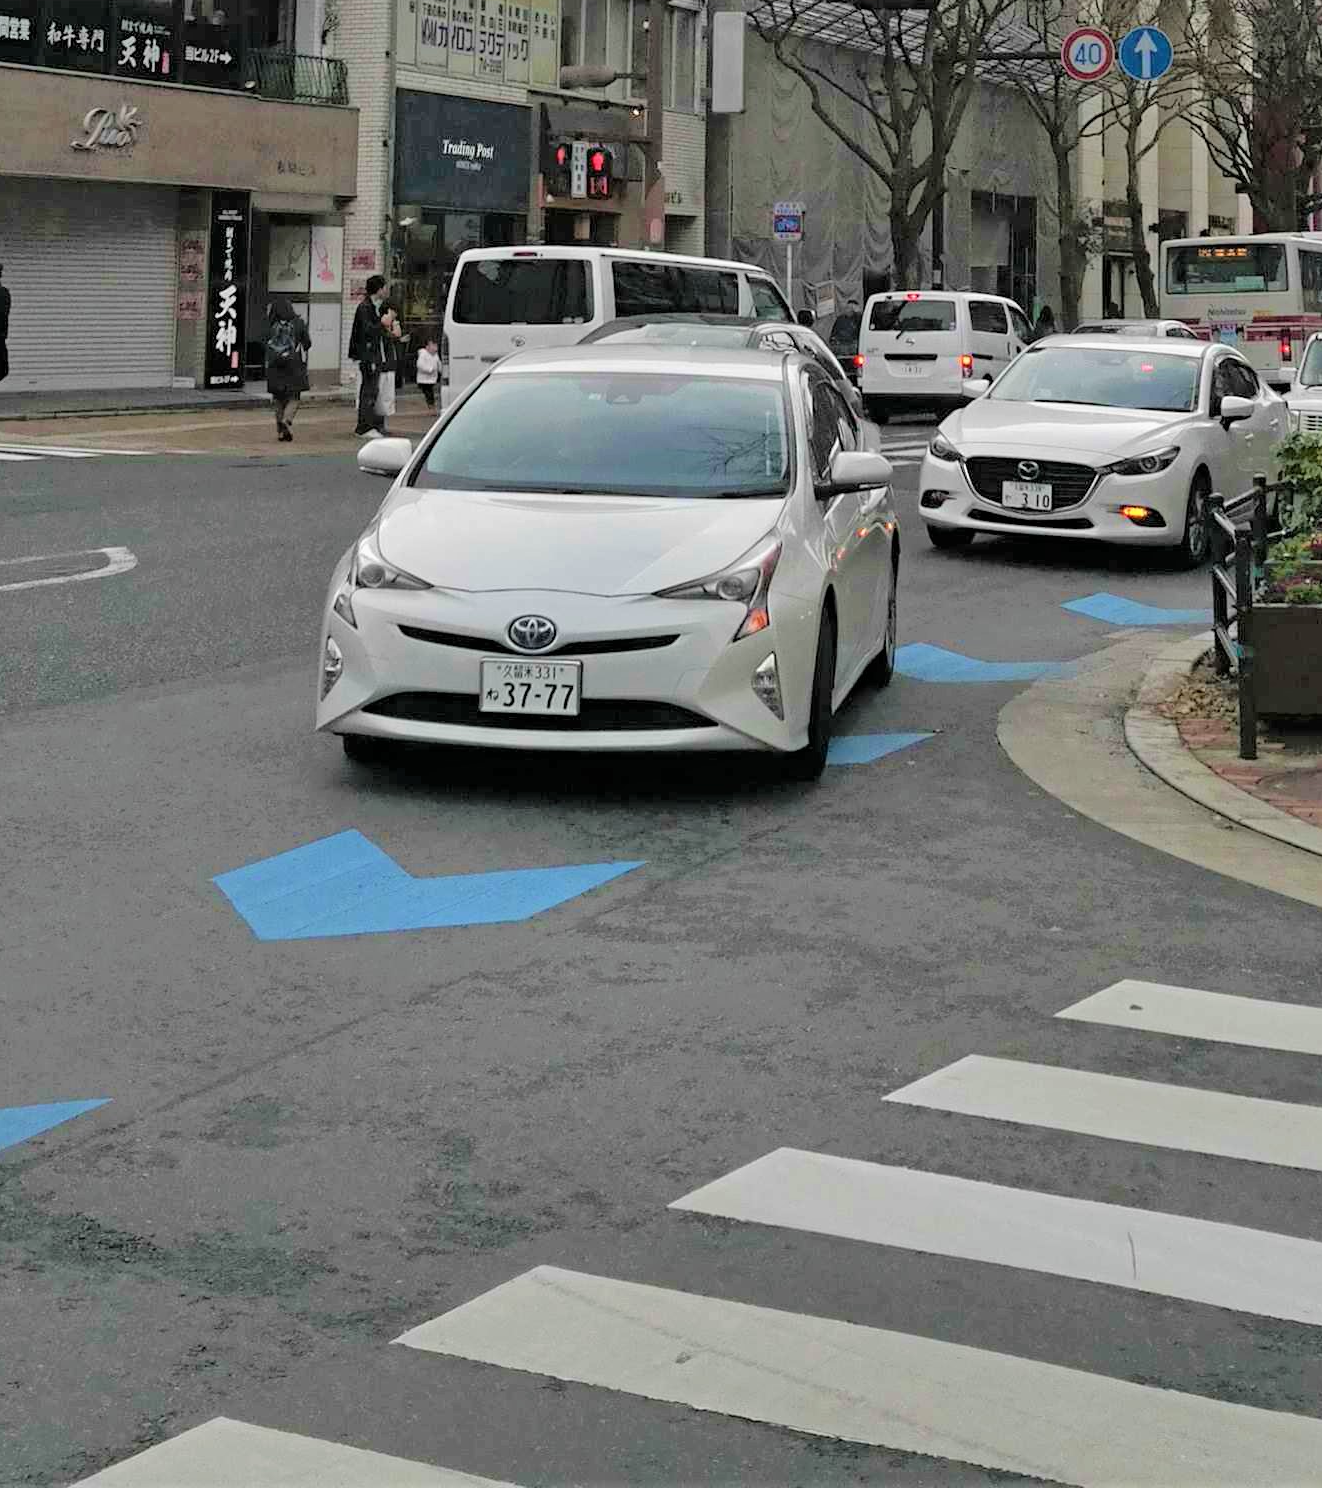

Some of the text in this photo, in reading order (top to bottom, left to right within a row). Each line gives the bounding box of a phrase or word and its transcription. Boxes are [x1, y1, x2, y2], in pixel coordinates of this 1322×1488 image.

[47, 22, 105, 53] 和牛専門
[117, 36, 160, 72] 天神
[1074, 42, 1102, 65] 40
[443, 139, 494, 160] Trading Post
[214, 284, 237, 357] 天神
[535, 665, 557, 681] 331
[503, 682, 574, 710] 37-77
